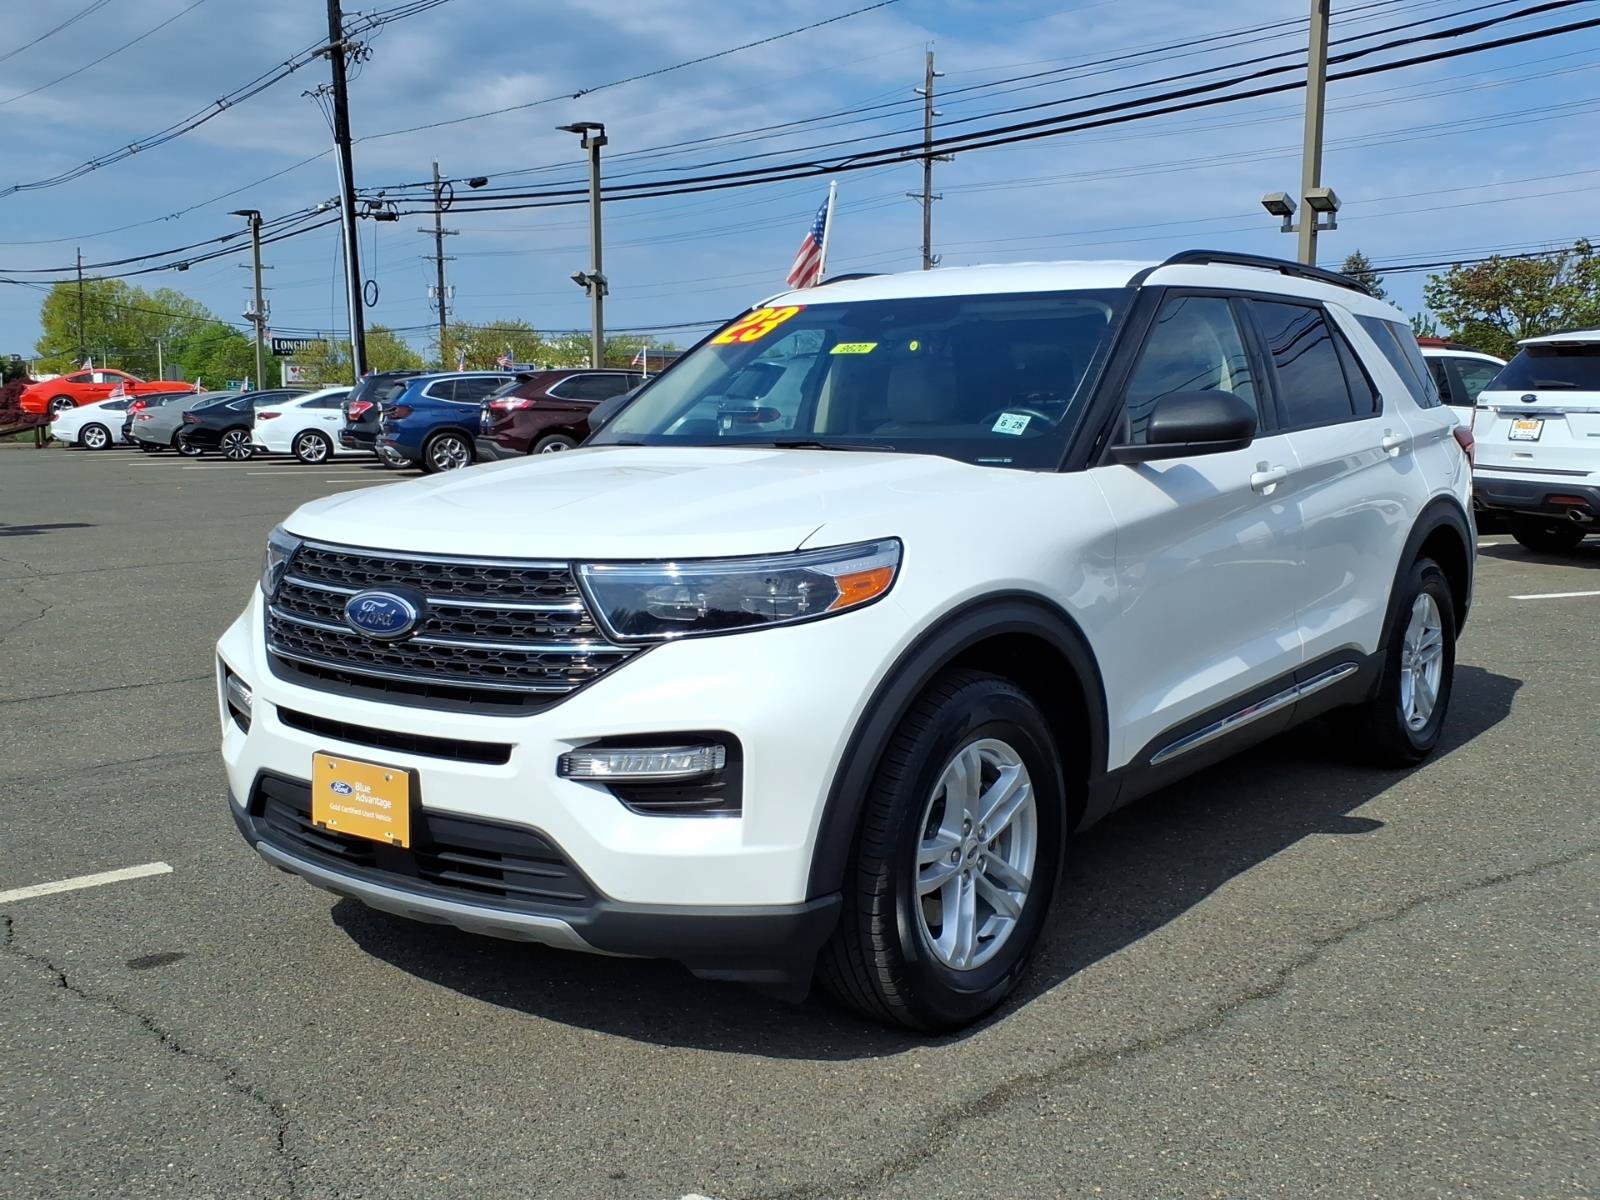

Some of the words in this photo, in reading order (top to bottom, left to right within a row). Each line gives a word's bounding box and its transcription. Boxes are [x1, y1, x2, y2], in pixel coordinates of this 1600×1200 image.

[709, 306, 800, 344] 23
[275, 340, 323, 351] LONGHO
[357, 600, 397, 626] Ford
[331, 781, 350, 794] Ford
[355, 782, 371, 793] Blue
[355, 793, 393, 809] Advantage
[329, 802, 340, 812] Gold
[341, 805, 361, 816] Certified
[361, 809, 375, 819] Used
